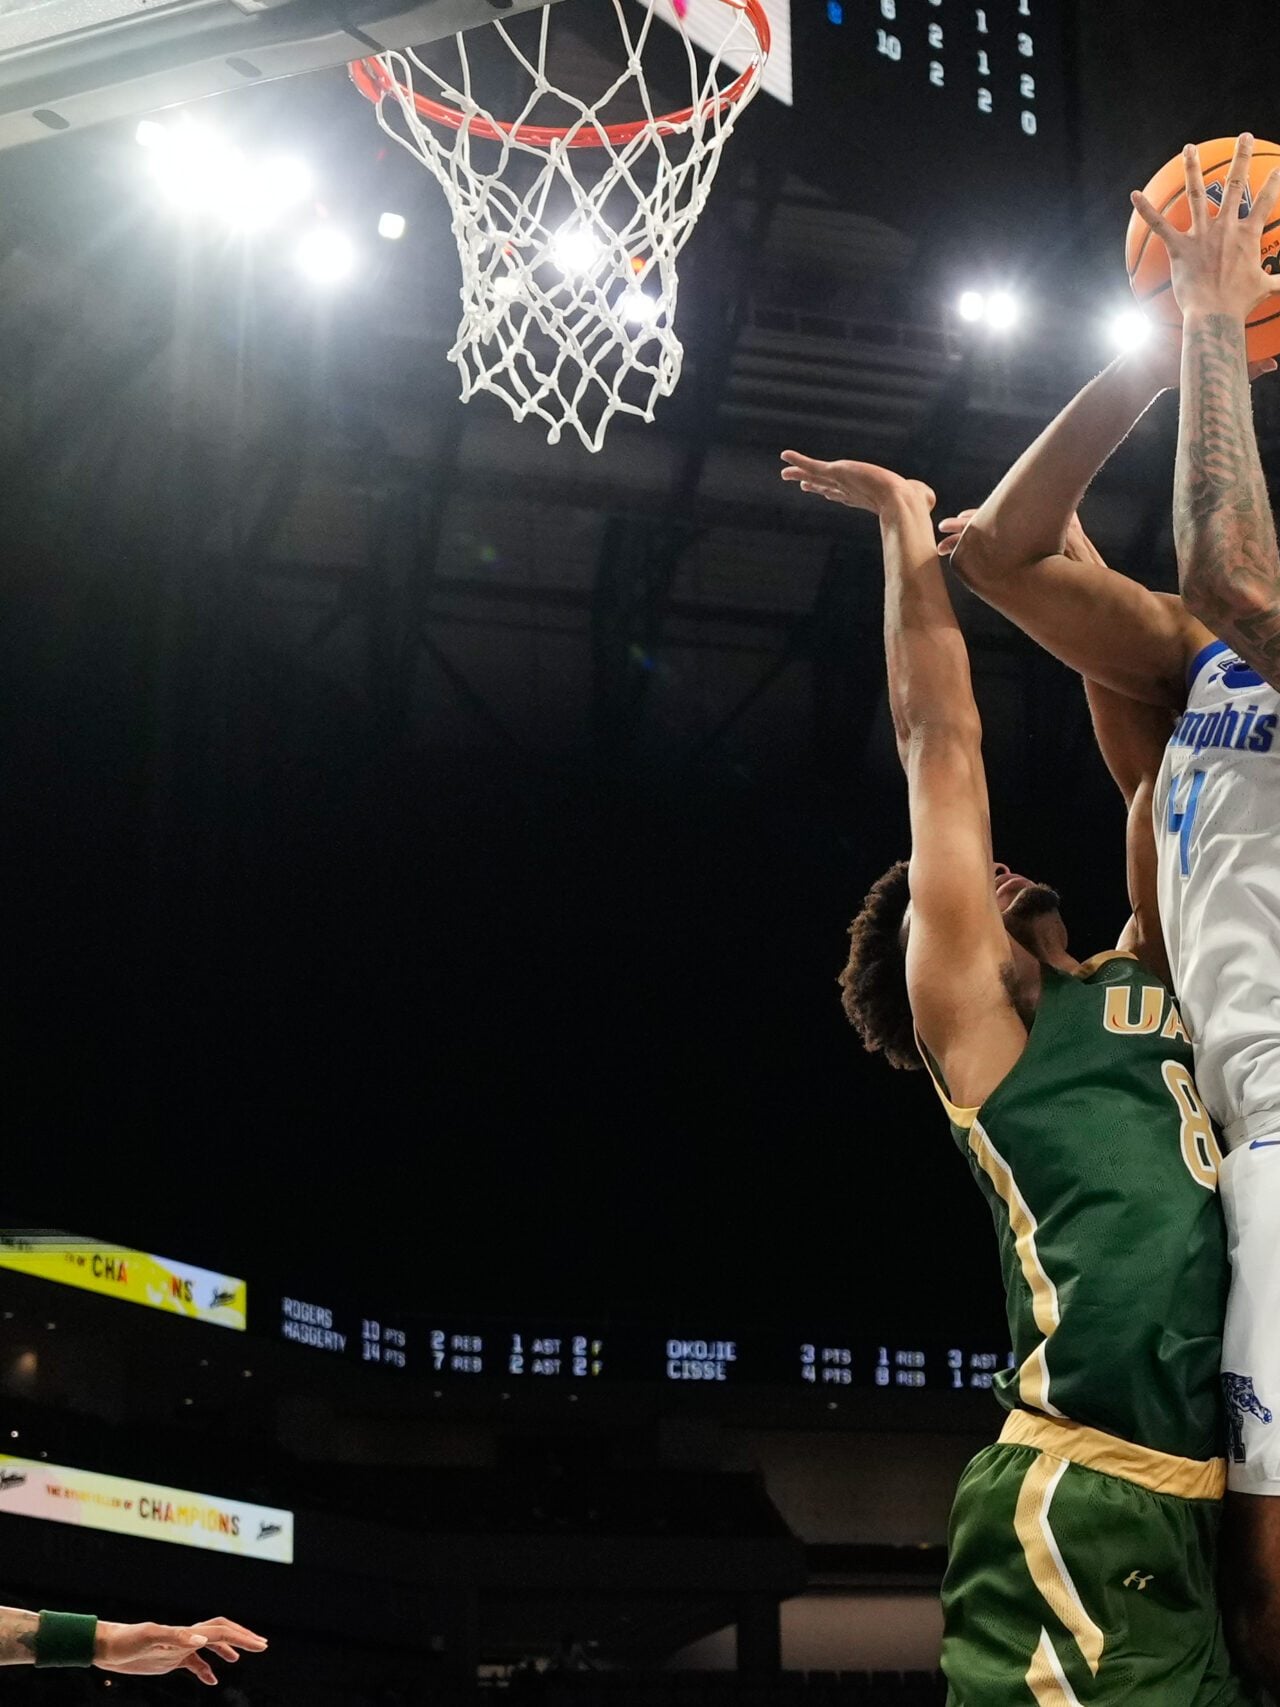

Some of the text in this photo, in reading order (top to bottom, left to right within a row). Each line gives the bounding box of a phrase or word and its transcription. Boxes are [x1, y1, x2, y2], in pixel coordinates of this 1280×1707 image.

[928, 22, 943, 48] 2
[978, 50, 990, 75] 1
[1020, 73, 1035, 98] 2
[976, 9, 1033, 57] 1 3
[876, 29, 1037, 135] 10 2 2 0
[1171, 703, 1278, 757] mphis
[1168, 769, 1206, 876] 4
[1103, 986, 1191, 1044] UA
[1161, 1060, 1222, 1193] 8
[282, 1297, 333, 1329] ROGERS
[430, 1330, 445, 1350] 2
[511, 1333, 523, 1354] 1
[531, 1338, 562, 1355] AST
[572, 1336, 587, 1356] 2
[666, 1339, 737, 1361] OKOJIE
[800, 1344, 815, 1364] 3
[877, 1346, 890, 1366] 1
[948, 1349, 962, 1368] 3
[432, 1350, 445, 1371] 7
[509, 1354, 524, 1375] 2
[531, 1358, 562, 1375] AST
[572, 1357, 587, 1376] 2
[666, 1359, 727, 1381] CISSE
[801, 1364, 816, 1383] 4
[952, 1368, 963, 1388] 1
[971, 1373, 993, 1389] AS
[139, 1497, 240, 1537] CHAMPIONS
